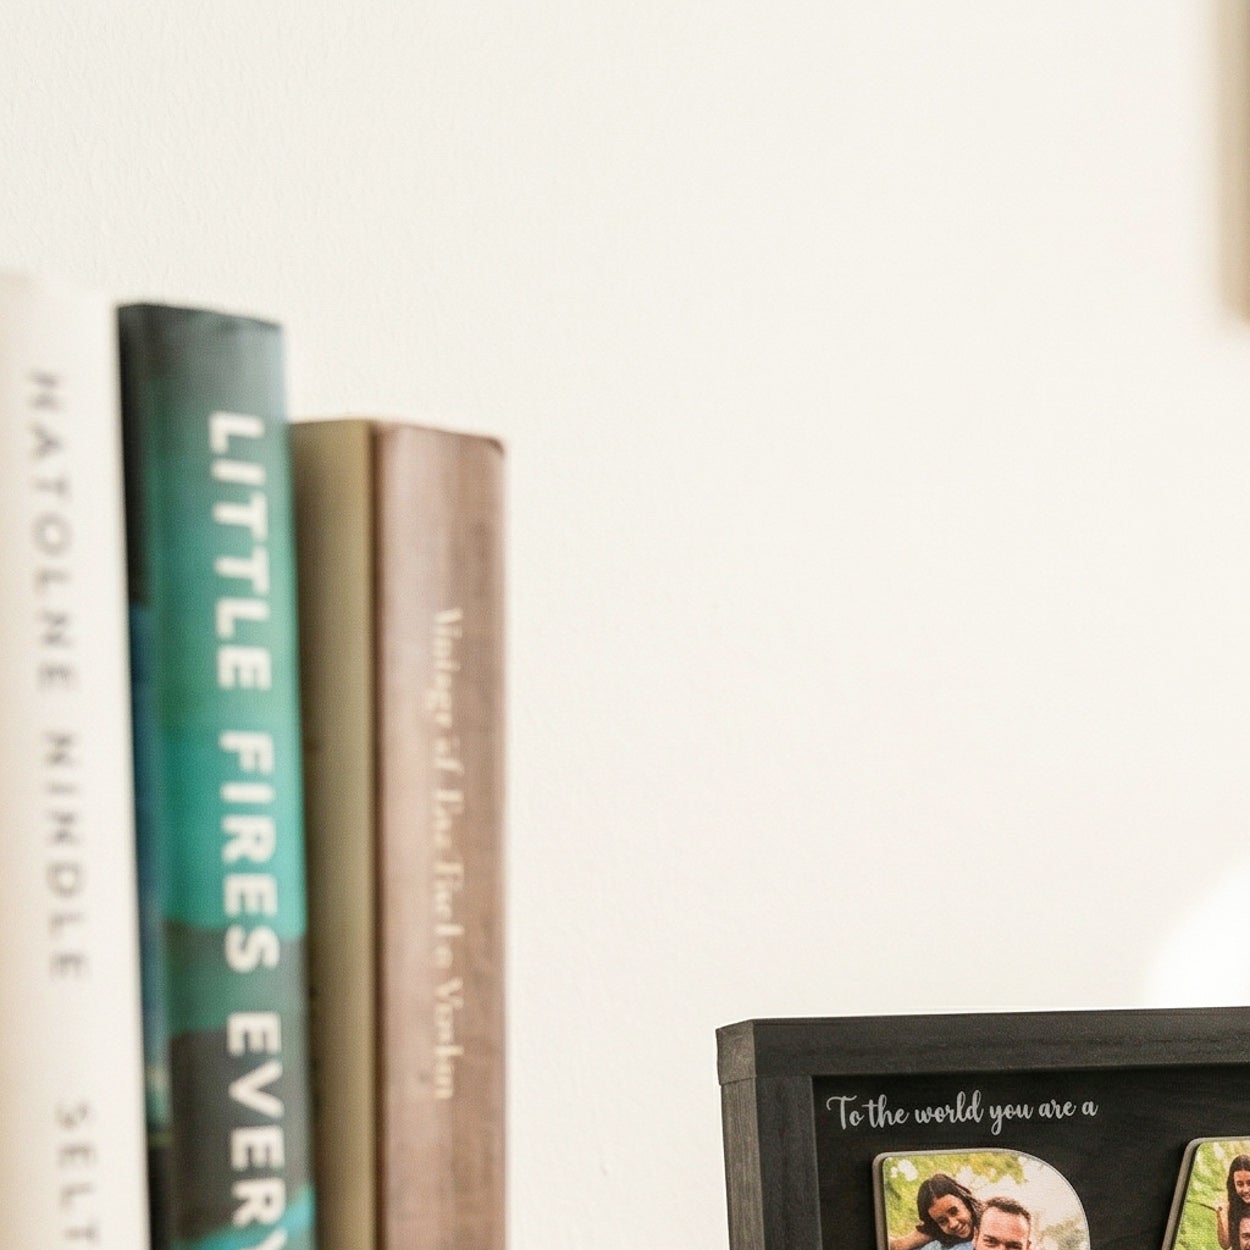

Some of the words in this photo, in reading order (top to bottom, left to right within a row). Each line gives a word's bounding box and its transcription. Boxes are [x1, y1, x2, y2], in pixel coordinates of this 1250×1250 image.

[209, 411, 271, 691] LITTLE
[220, 731, 280, 975] FIRES
[826, 1095, 863, 1130] To
[864, 1094, 908, 1128] the
[914, 1090, 984, 1123] world
[989, 1103, 1034, 1136] you
[1038, 1100, 1077, 1118] are
[1082, 1101, 1099, 1117] a
